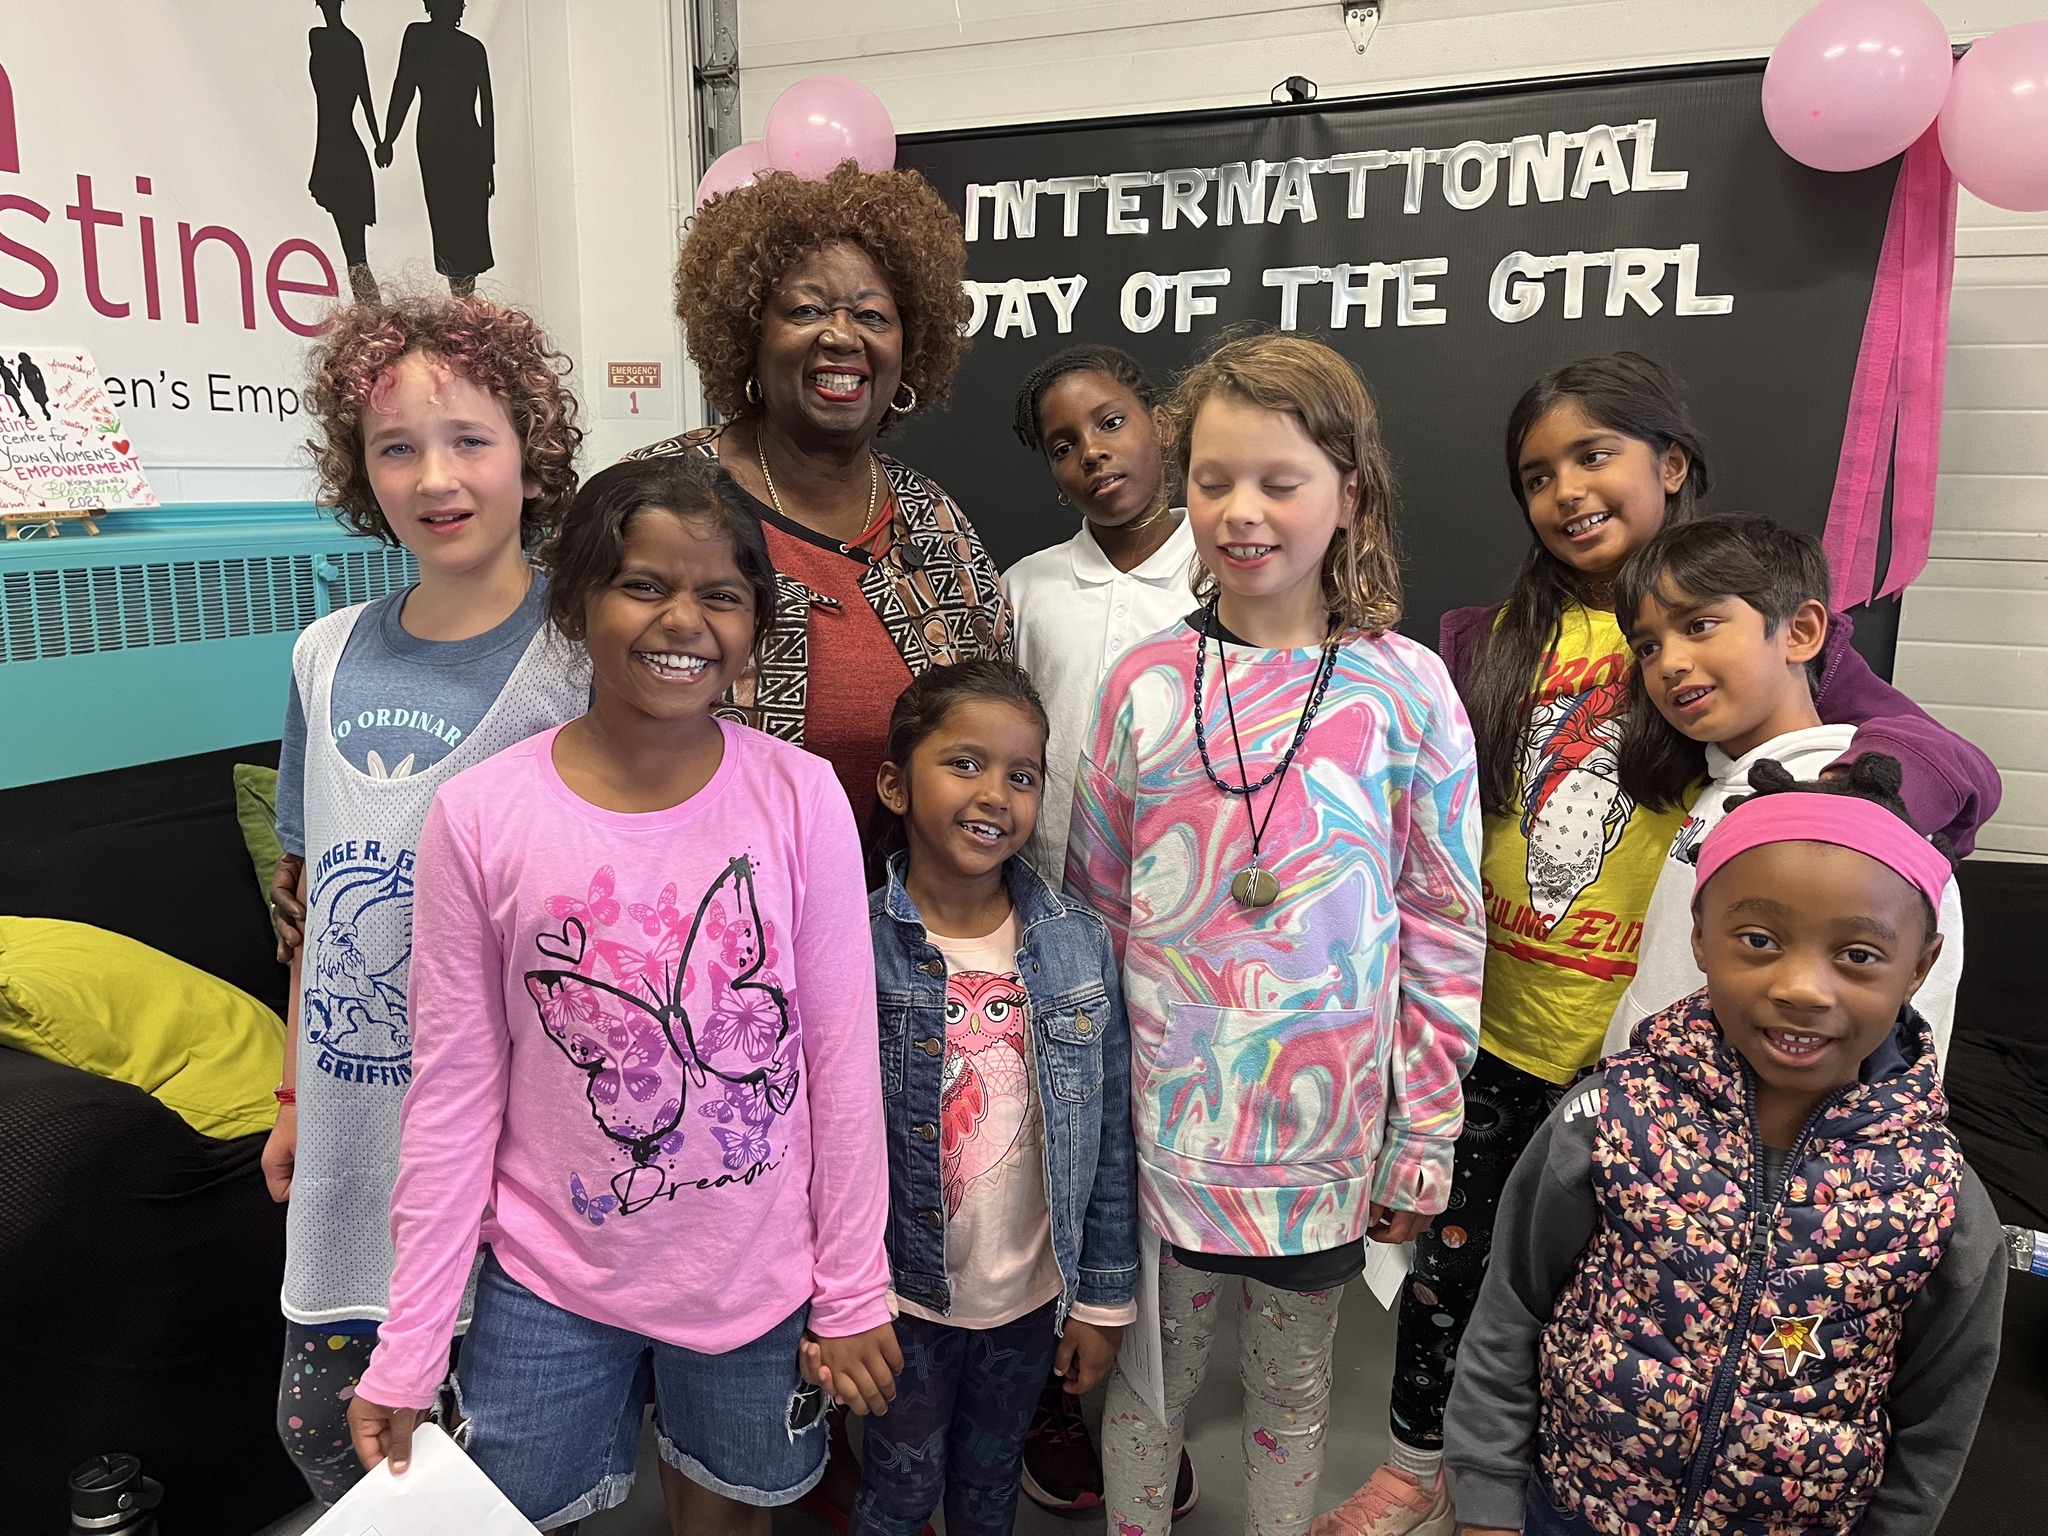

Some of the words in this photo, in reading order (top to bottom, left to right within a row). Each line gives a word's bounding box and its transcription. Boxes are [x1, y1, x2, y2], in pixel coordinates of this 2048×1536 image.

[964, 119, 1688, 242] INTERNATIONAL
[1120, 268, 1231, 334] OF
[1263, 257, 1448, 331] THE
[611, 366, 658, 375] EMERGENCY
[612, 375, 657, 384] EXIT
[629, 390, 639, 414] 1
[49, 426, 69, 442] for
[14, 457, 141, 481] EMPOWERMENT
